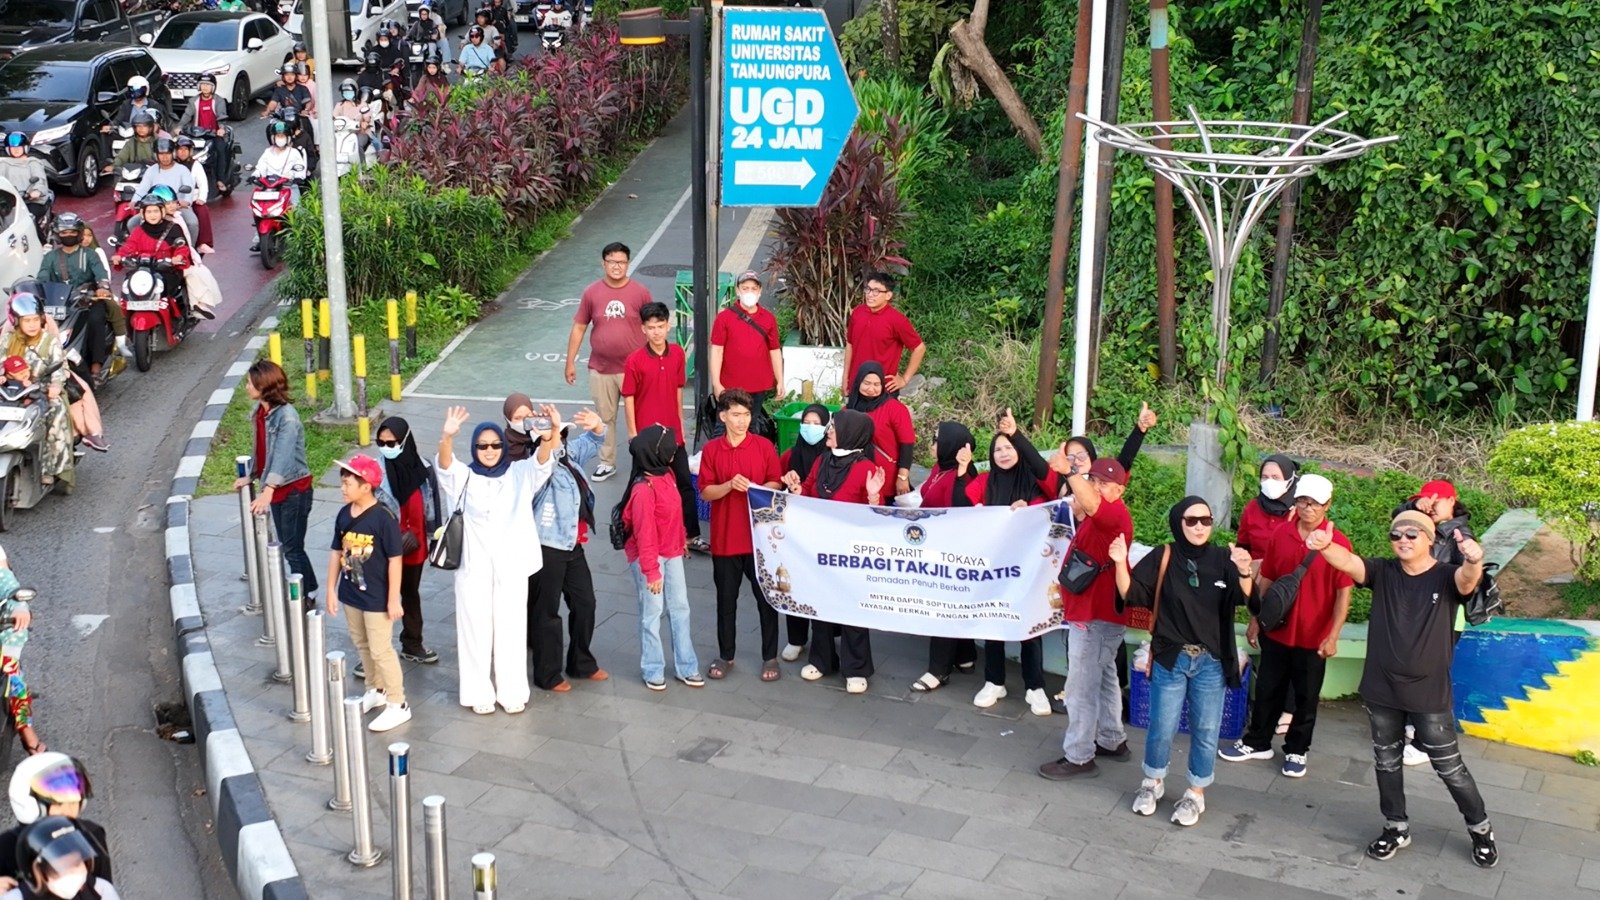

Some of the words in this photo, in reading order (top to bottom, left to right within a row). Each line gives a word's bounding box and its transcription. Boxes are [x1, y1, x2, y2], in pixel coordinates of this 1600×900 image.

[731, 24, 781, 41] RUMAH
[784, 26, 825, 42] SAKIT
[731, 44, 821, 61] UNIVERSITAS
[731, 63, 831, 81] TANJUNGPURA
[729, 87, 825, 126] UGD
[731, 126, 763, 149] 24
[768, 127, 823, 150] JAM
[853, 544, 885, 557] SPPG
[890, 546, 923, 559] PARIT
[941, 552, 986, 567] TOKAYA
[817, 552, 892, 571] BERBAGI
[898, 559, 953, 579] TAKJIL
[955, 565, 1022, 582] GRATIS
[866, 575, 910, 586] Ramadan
[911, 578, 938, 589] Penuh
[939, 582, 971, 593] Berkah
[869, 593, 896, 602] MITRA
[897, 596, 925, 606] DAPUR
[860, 602, 894, 612] YAYASAN
[898, 607, 931, 616] BERKAH
[936, 611, 969, 620] PANGAN
[972, 610, 1021, 621] KALIMANTAN
